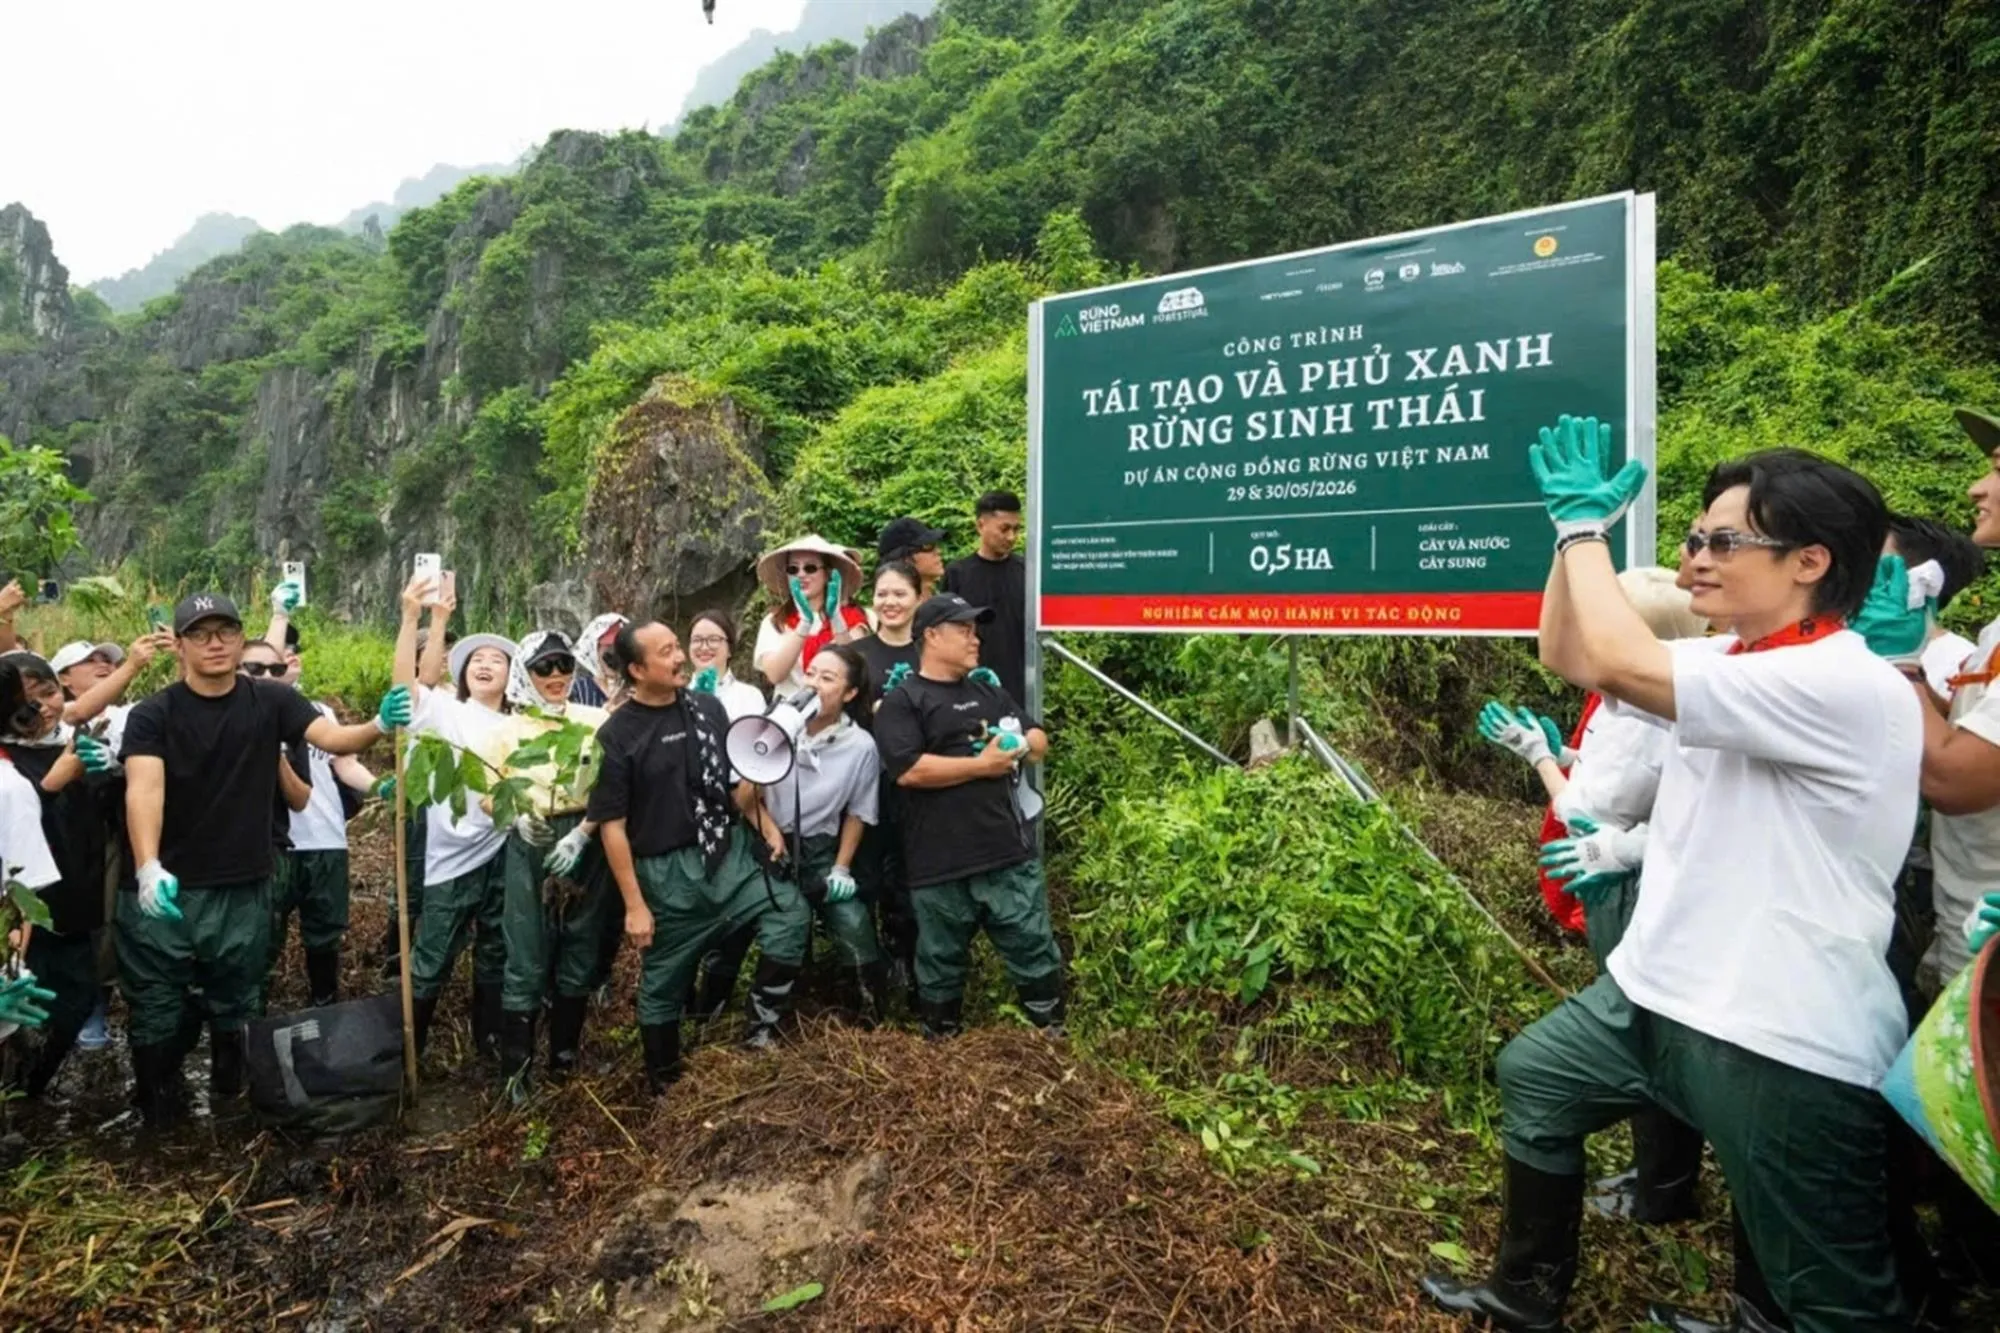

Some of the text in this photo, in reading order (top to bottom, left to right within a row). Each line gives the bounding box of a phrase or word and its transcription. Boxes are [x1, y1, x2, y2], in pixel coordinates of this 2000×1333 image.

[1079, 313, 1145, 334] VIETNAM
[1223, 324, 1363, 357] CÔNG TRÌNH
[1082, 332, 1554, 416] TÁI TẠO VÀ PHỦ XANH
[1127, 383, 1487, 452] RỪNG SINH THÁI
[1123, 468, 1149, 488] DỰ
[1153, 465, 1179, 483] ÁN
[1183, 462, 1237, 483] CỘNG
[1308, 452, 1368, 473] RỪNG
[1375, 445, 1430, 470] VIỆT
[1436, 443, 1491, 464] NAM
[1227, 479, 1357, 501] 29 & 30/05/2026
[1419, 534, 1511, 552] CÂY VÀ NƯỚC
[1249, 543, 1334, 577] 0,5 HA
[1419, 554, 1488, 570] CÂY SUNG
[1142, 604, 1203, 620] NGHIÊM
[1248, 606, 1281, 622] MỌI
[1285, 604, 1336, 621] HÀNH
[1341, 606, 1361, 621] VI
[1366, 604, 1400, 621] TÁC
[1407, 603, 1463, 622] ĐỘNG
